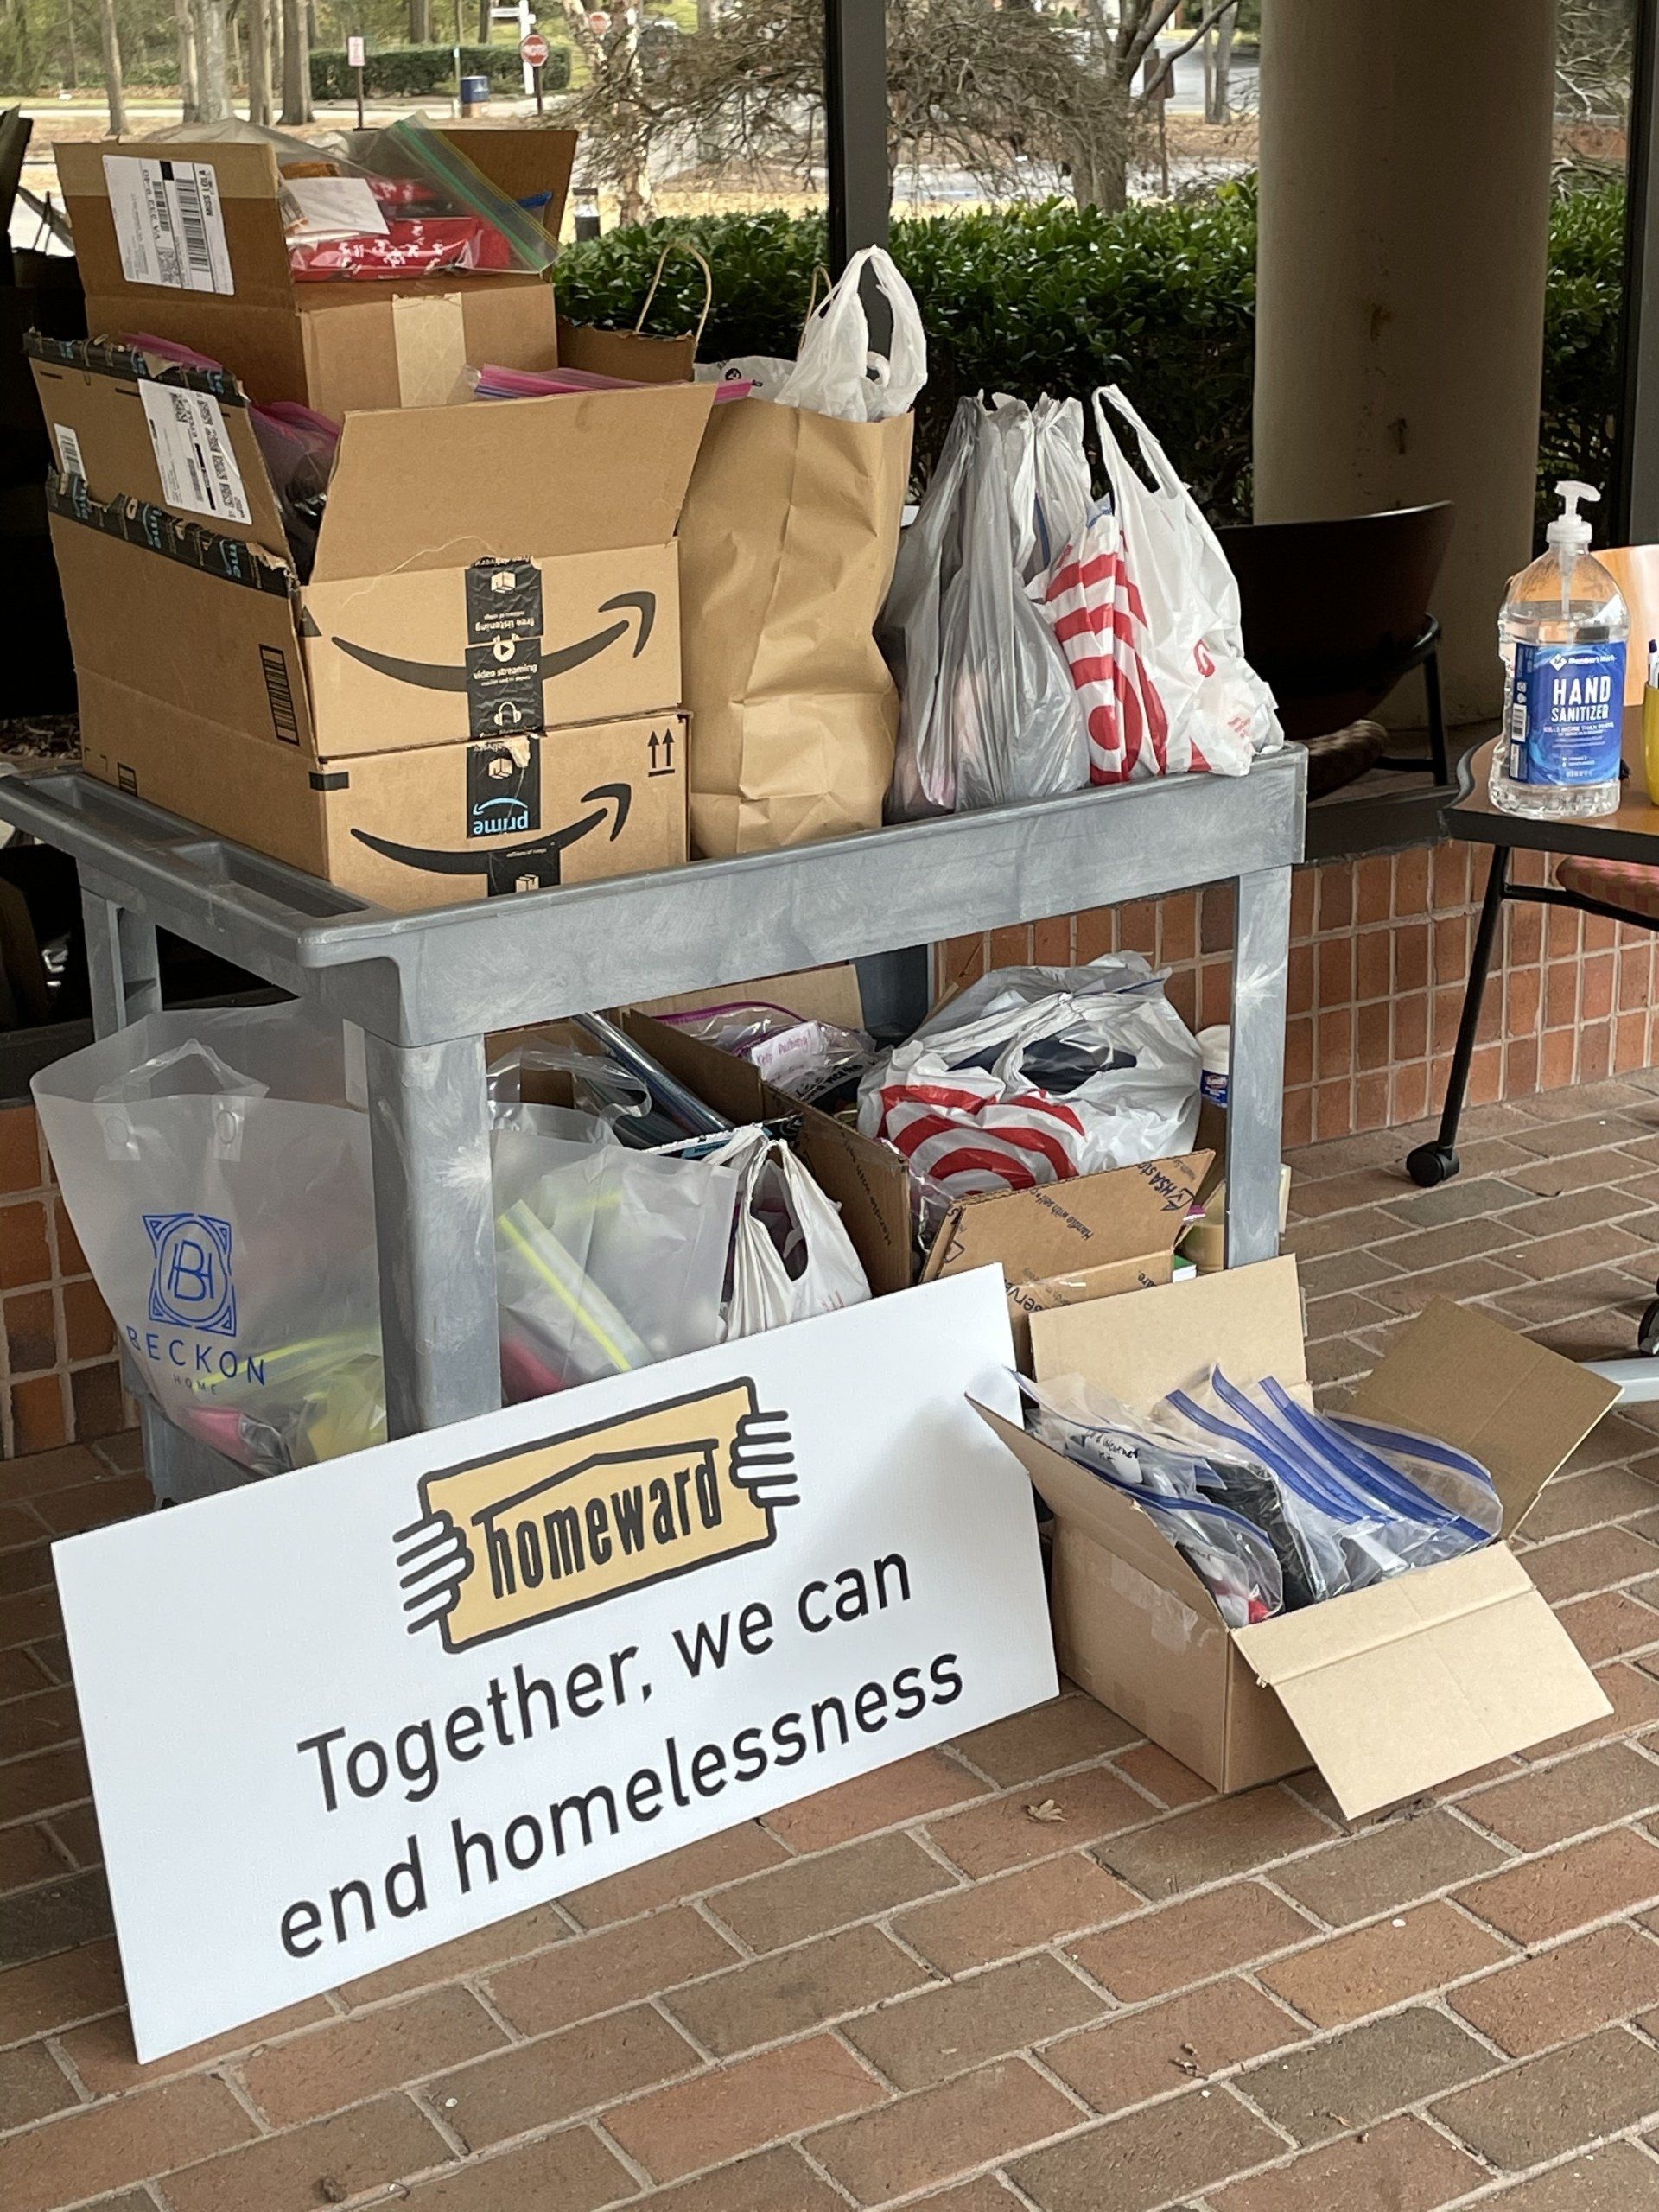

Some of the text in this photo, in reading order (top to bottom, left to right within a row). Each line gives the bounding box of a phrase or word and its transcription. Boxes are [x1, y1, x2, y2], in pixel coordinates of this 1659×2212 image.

[474, 620, 515, 632] listening
[1553, 676, 1611, 705] HAND
[1551, 704, 1609, 722] SANITIZER
[473, 810, 529, 835] prime
[1150, 1170, 1177, 1198] HSA
[1051, 1204, 1069, 1220] with
[1066, 1216, 1094, 1241] Handle
[126, 1325, 264, 1386] BECKON
[173, 1373, 216, 1395] HOME
[474, 1445, 723, 1599] homeward
[298, 1554, 910, 1810] Together, we can
[282, 1654, 962, 1959] end homelessness
